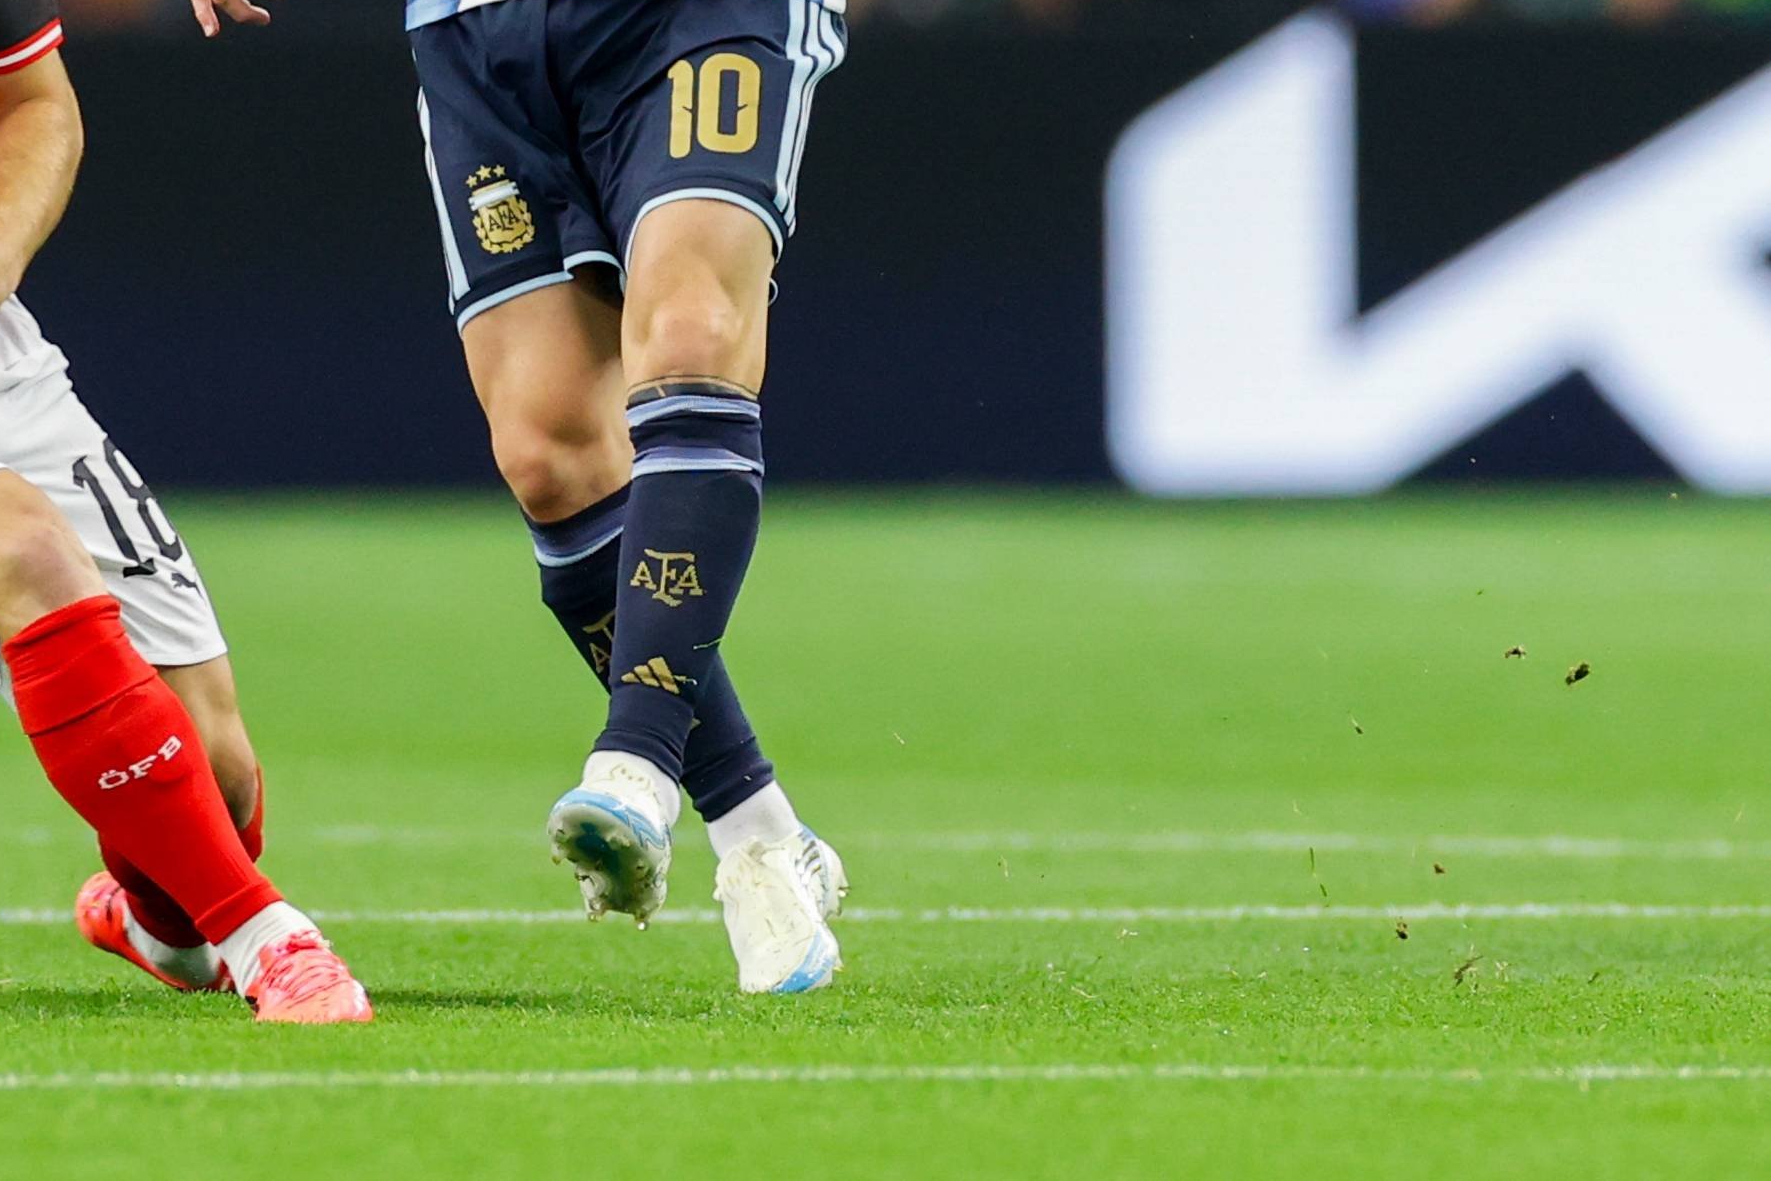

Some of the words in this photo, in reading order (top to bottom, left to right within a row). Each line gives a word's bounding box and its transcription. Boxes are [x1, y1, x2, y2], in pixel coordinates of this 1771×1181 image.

[668, 53, 761, 159] 10
[488, 200, 520, 232] AFA
[72, 438, 183, 578] 18
[630, 548, 706, 608] AFA
[97, 734, 183, 791] ÖFB
